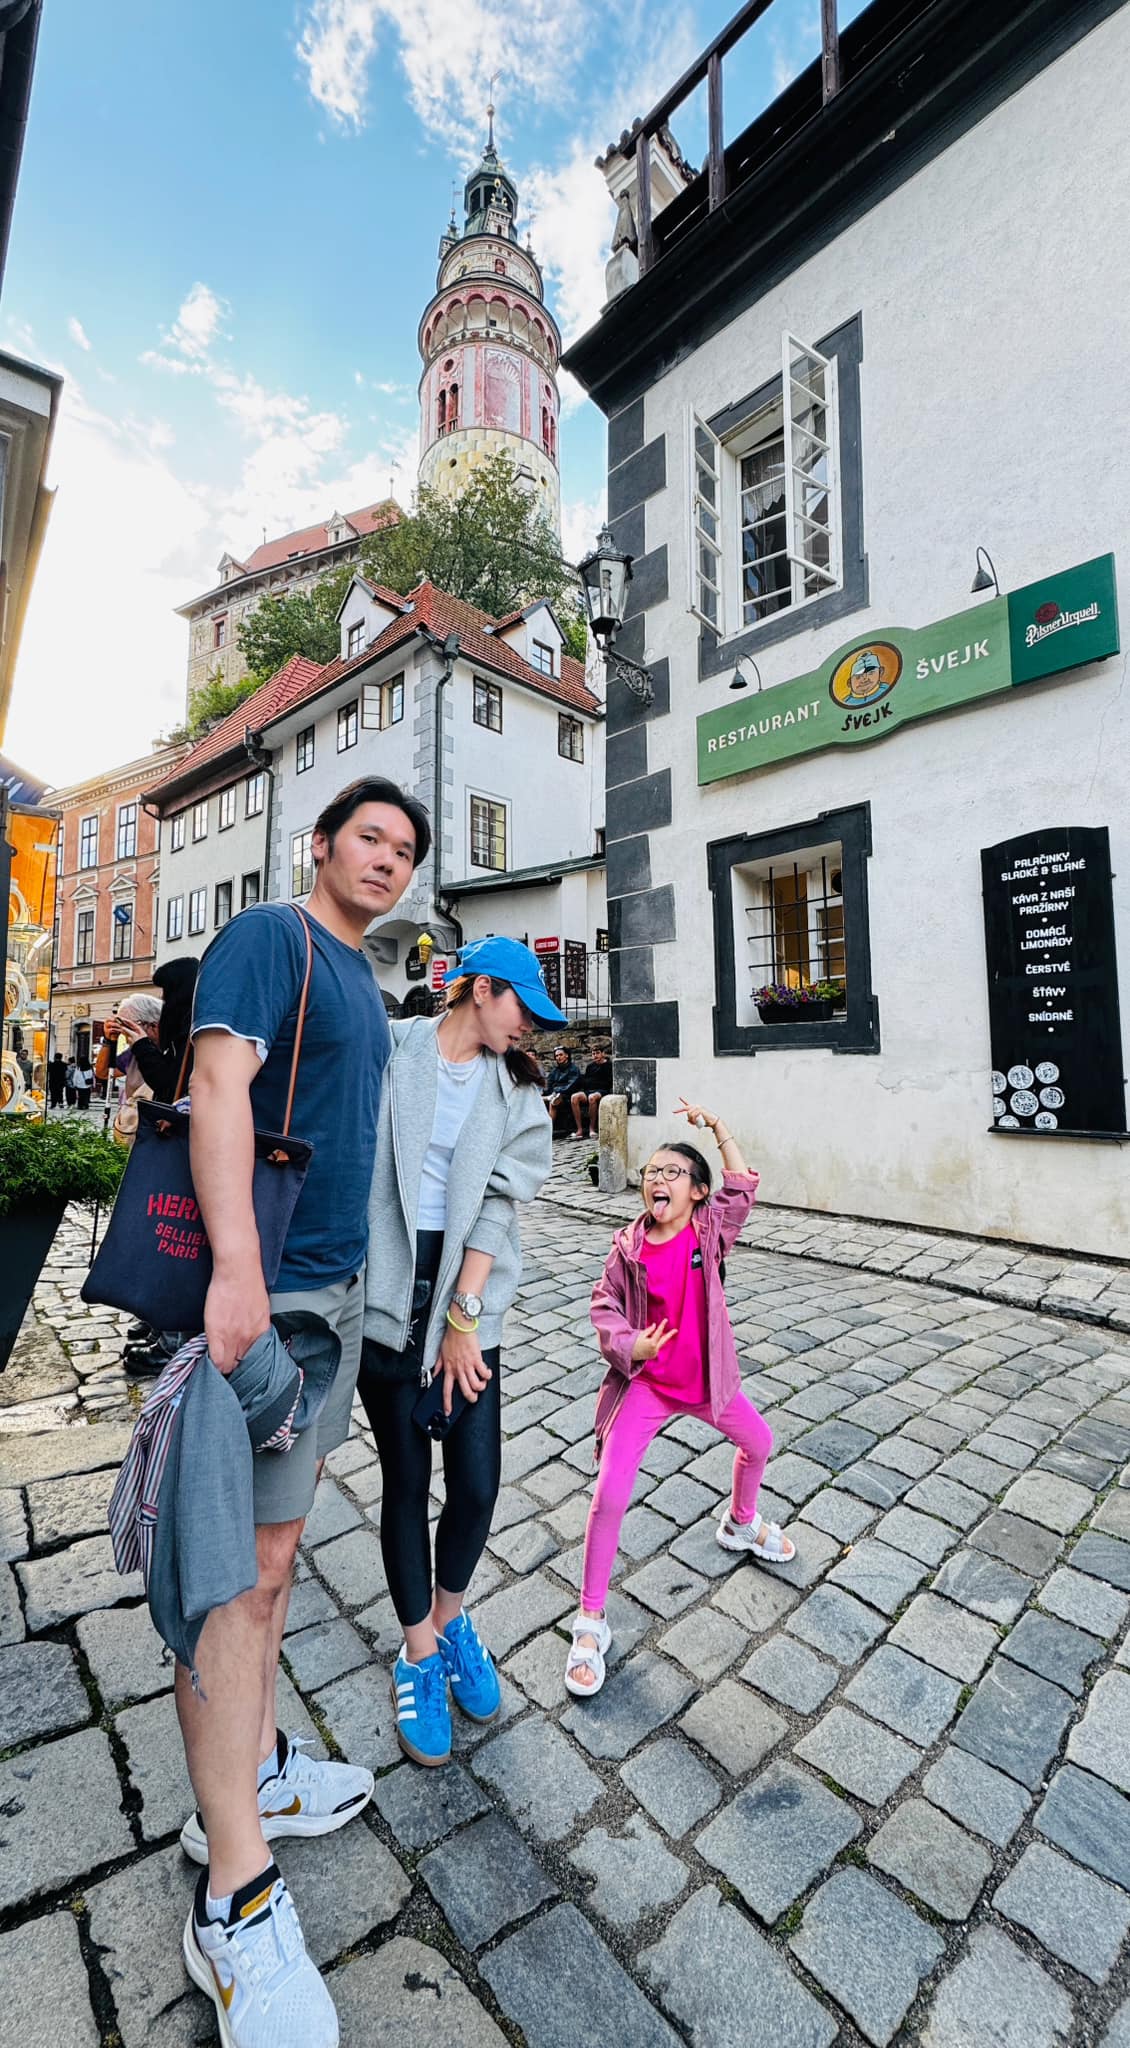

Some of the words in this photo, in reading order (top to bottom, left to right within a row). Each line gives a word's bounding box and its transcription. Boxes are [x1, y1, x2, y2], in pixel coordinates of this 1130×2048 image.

[1025, 619, 1061, 648] Pilsner
[707, 700, 821, 753] RESTAURANT
[916, 638, 990, 680] ŠVEJK
[841, 702, 894, 732] ŠVEJK
[1000, 866, 1039, 881] SLADKÉ
[1051, 857, 1086, 874] SLANÉ
[1014, 851, 1070, 869] PALAČINKY
[1012, 893, 1039, 905] KÁVA
[1040, 892, 1048, 901] Z
[1050, 886, 1076, 900] NAŠÍ
[1019, 901, 1069, 916] PRAŽÍRNY
[1025, 924, 1066, 939] DOMÁCÍ
[1020, 936, 1073, 951] LIMONÁDY
[1025, 960, 1072, 975] ČERSTVÉ
[1028, 1009, 1074, 1022] SNÍDANĚ
[157, 1239, 199, 1260] PARIS
